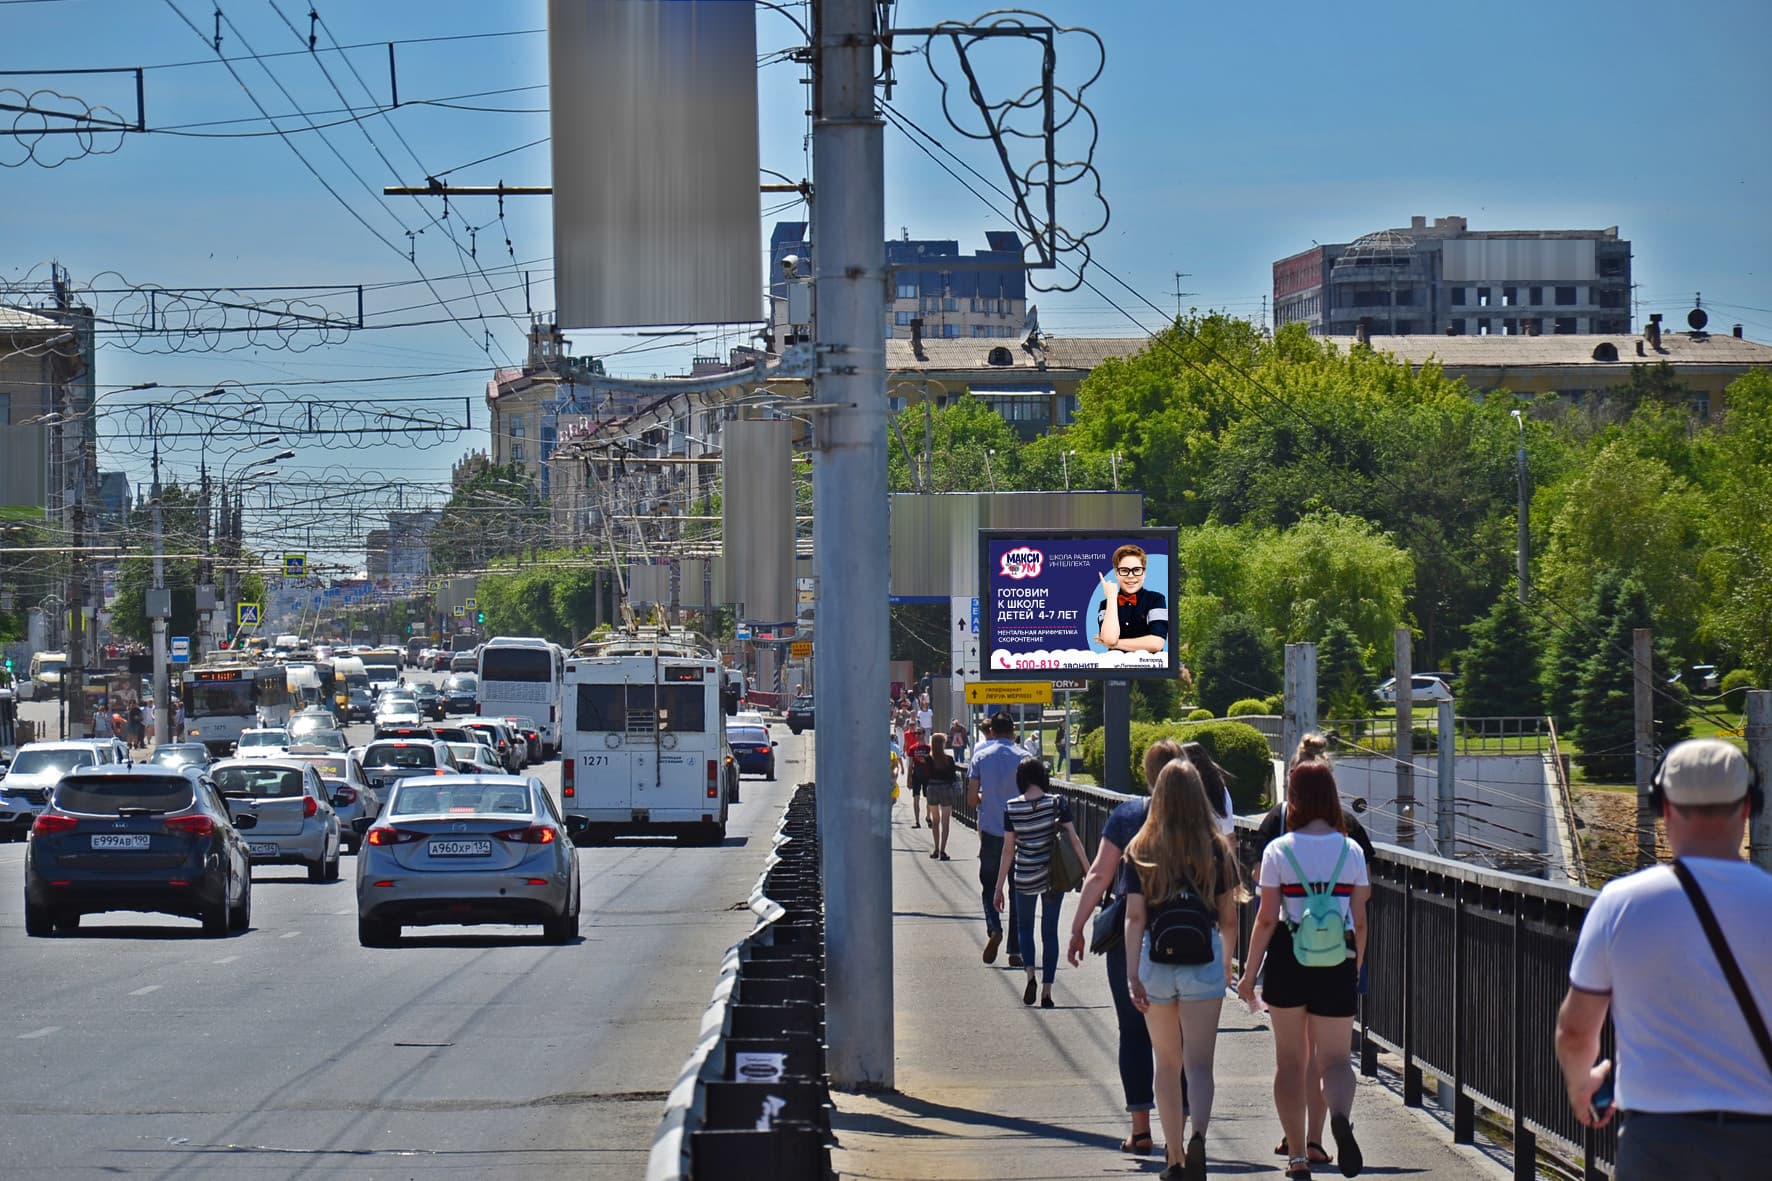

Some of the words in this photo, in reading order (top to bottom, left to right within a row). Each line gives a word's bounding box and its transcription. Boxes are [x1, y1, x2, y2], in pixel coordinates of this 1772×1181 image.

[1007, 553, 1039, 563] МАКСИ
[1021, 563, 1036, 573] УМ
[997, 588, 1049, 598] ГОТОВИМ
[997, 599, 1005, 609] К
[1007, 599, 1046, 609] ШКОЛЕ
[997, 609, 1034, 622] ДЕТЕЙ
[1038, 610, 1055, 620] 4-7
[1057, 610, 1079, 620] ЛЕТ
[1015, 659, 1061, 669] 500-819
[583, 755, 609, 766] 1271
[93, 836, 132, 847] Е999АВ
[132, 835, 148, 845] 190
[431, 842, 472, 854] А960ХР
[473, 841, 489, 850] 134
